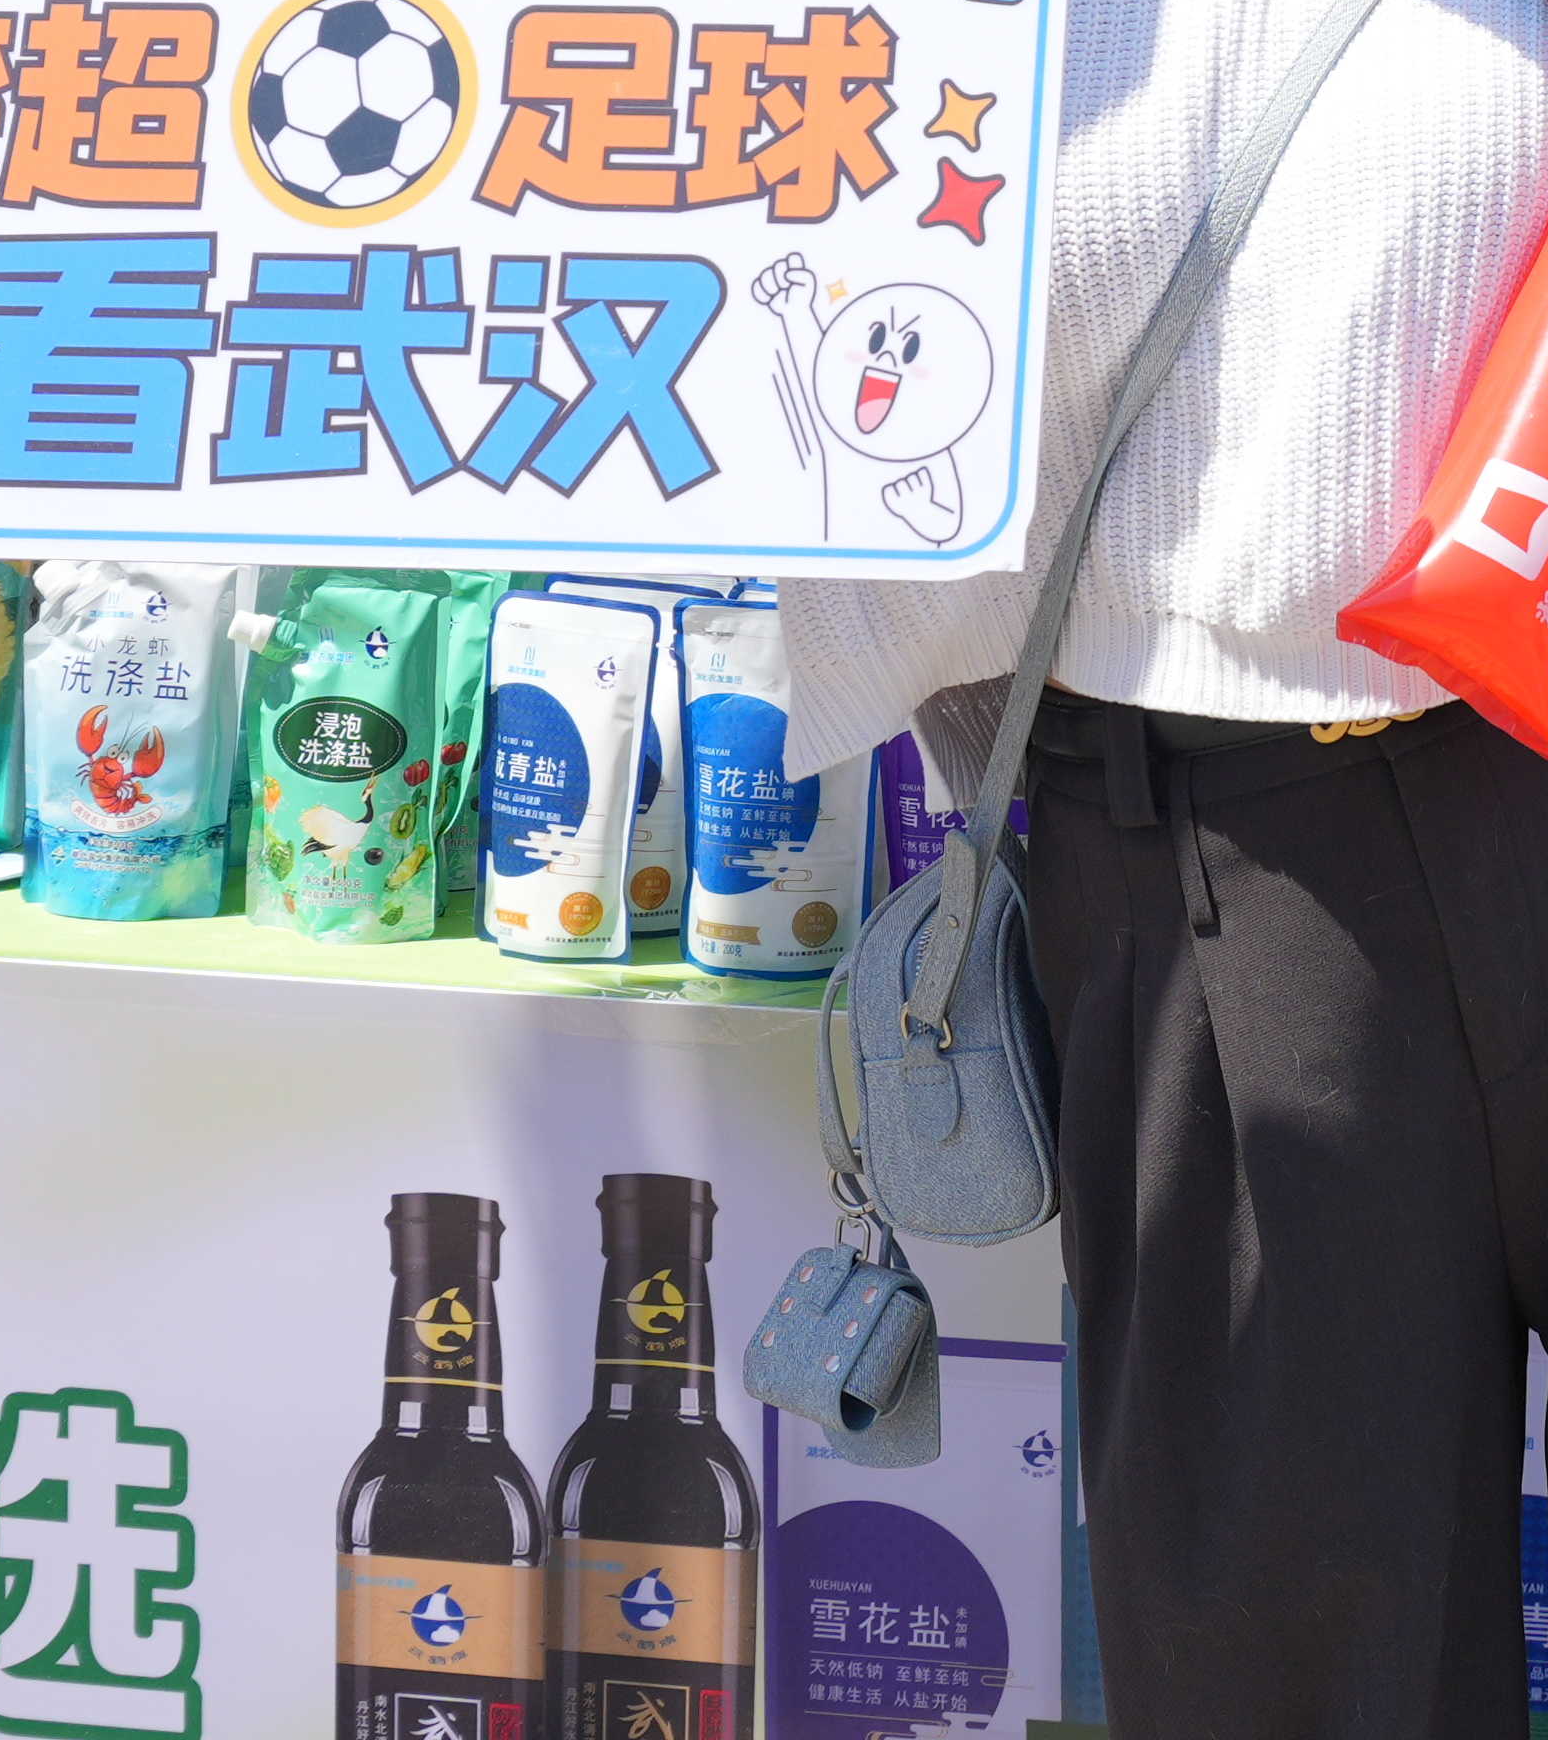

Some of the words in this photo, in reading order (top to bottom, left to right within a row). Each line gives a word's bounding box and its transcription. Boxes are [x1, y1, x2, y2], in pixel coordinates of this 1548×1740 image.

[477, 4, 906, 224] 足球
[85, 635, 172, 657] 小龙虾
[59, 655, 192, 702] 洗涤盐
[314, 710, 364, 741] 浸泡
[298, 737, 374, 770] 洗涤盐
[808, 1578, 873, 1595] XUEHUAYAN
[809, 1595, 952, 1654] 雪花盐
[955, 1606, 971, 1651] 未加碘
[809, 1659, 885, 1682] 天然低钠
[895, 1662, 971, 1688] 至鲜至纯
[809, 1683, 884, 1707] 健康生活
[893, 1688, 970, 1713] 从盐开始
